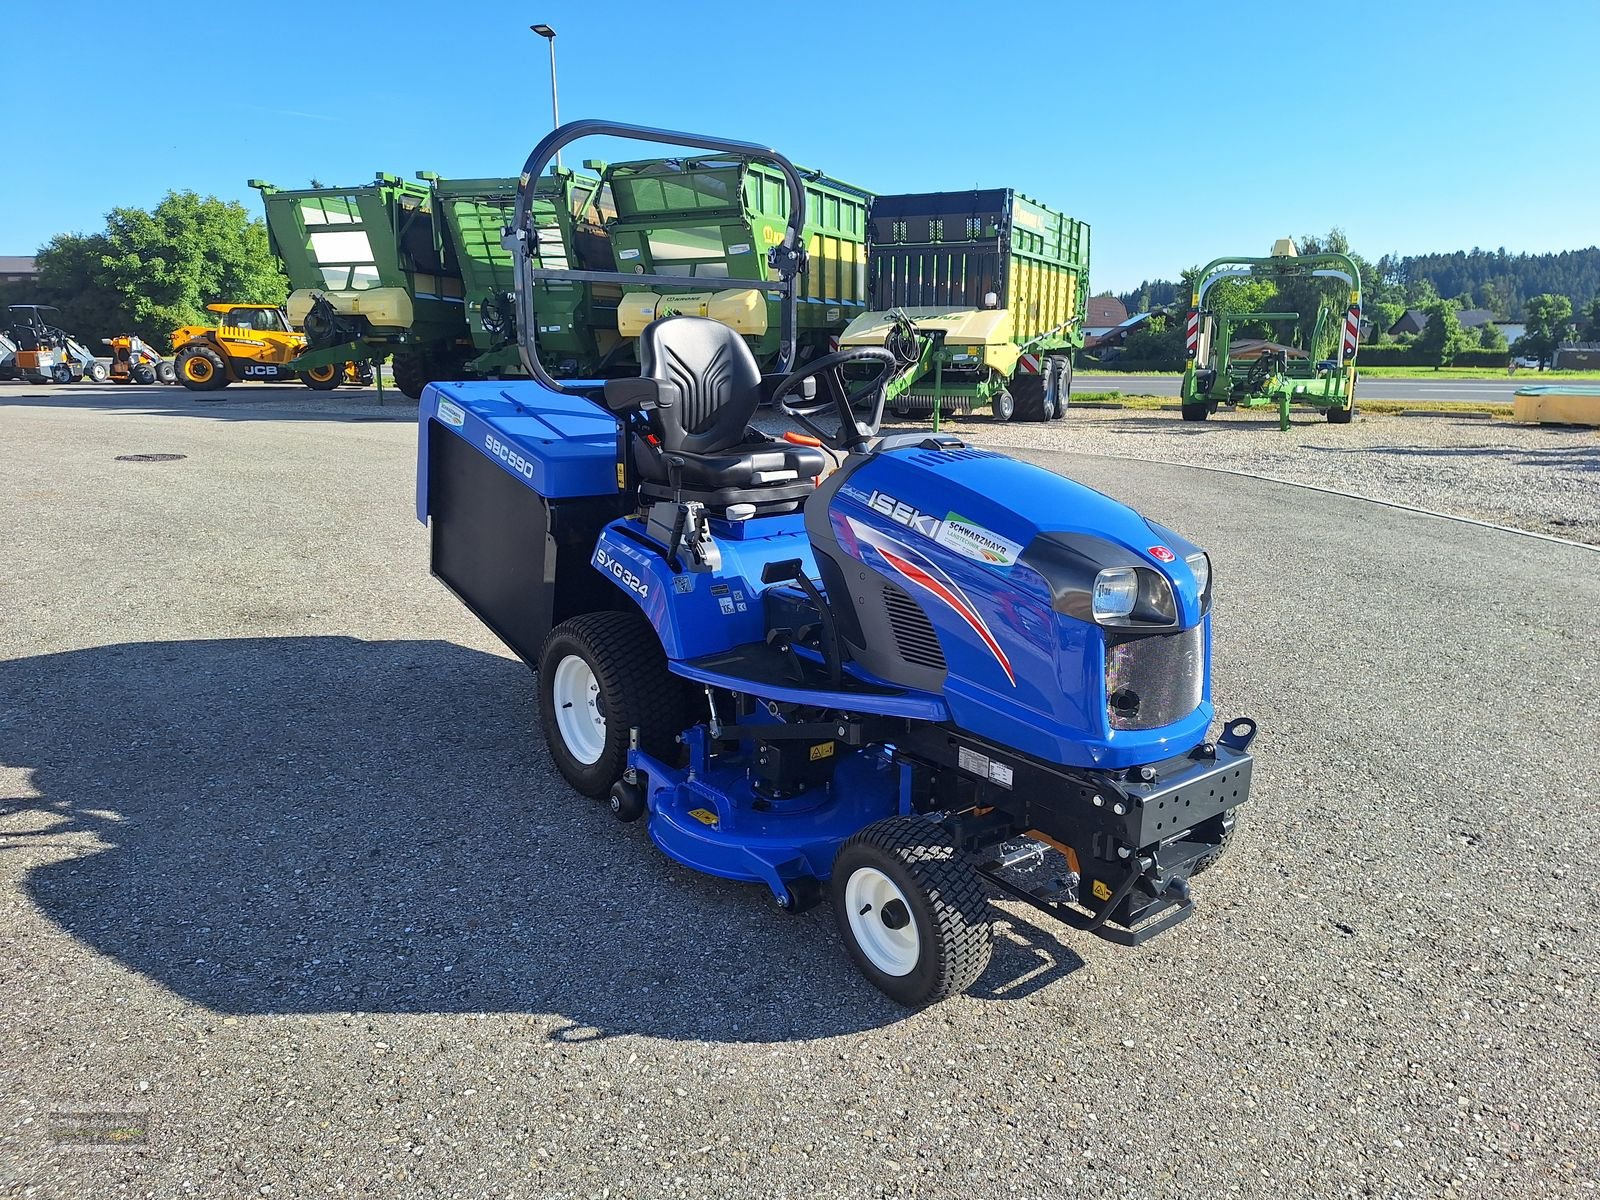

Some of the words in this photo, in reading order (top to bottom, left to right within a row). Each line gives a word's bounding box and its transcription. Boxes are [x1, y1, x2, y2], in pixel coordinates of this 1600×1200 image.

[245, 365, 278, 375] JCB
[484, 434, 533, 479] SBC590
[867, 489, 940, 539] ISEKI
[949, 521, 1007, 555] SCHWARZMAYR
